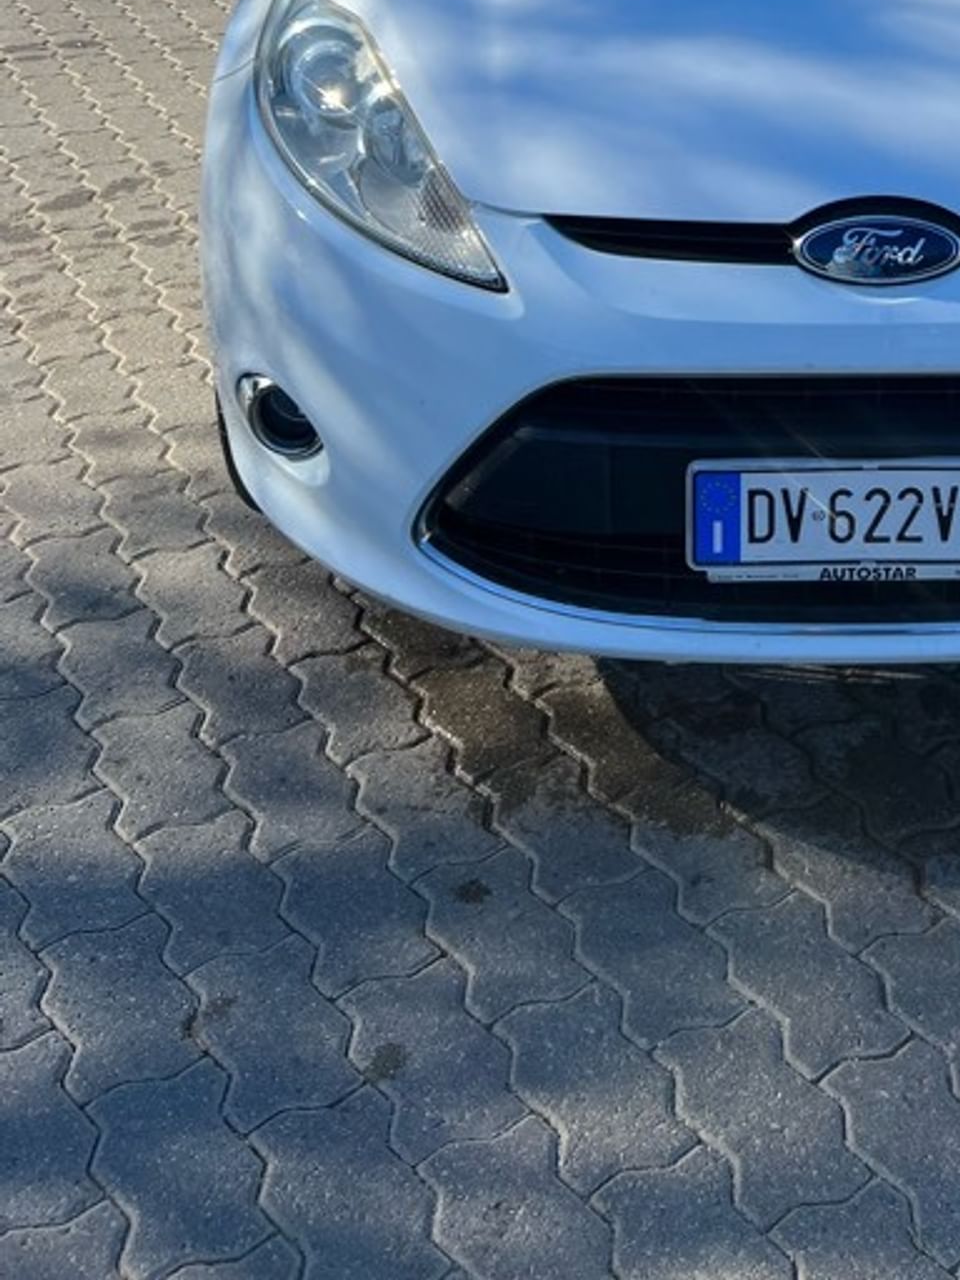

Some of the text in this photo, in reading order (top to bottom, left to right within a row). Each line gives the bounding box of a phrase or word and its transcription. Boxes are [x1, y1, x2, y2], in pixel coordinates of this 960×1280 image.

[832, 227, 925, 265] Ford
[747, 487, 809, 544] DV
[819, 567, 918, 581] AUTOSTAR
